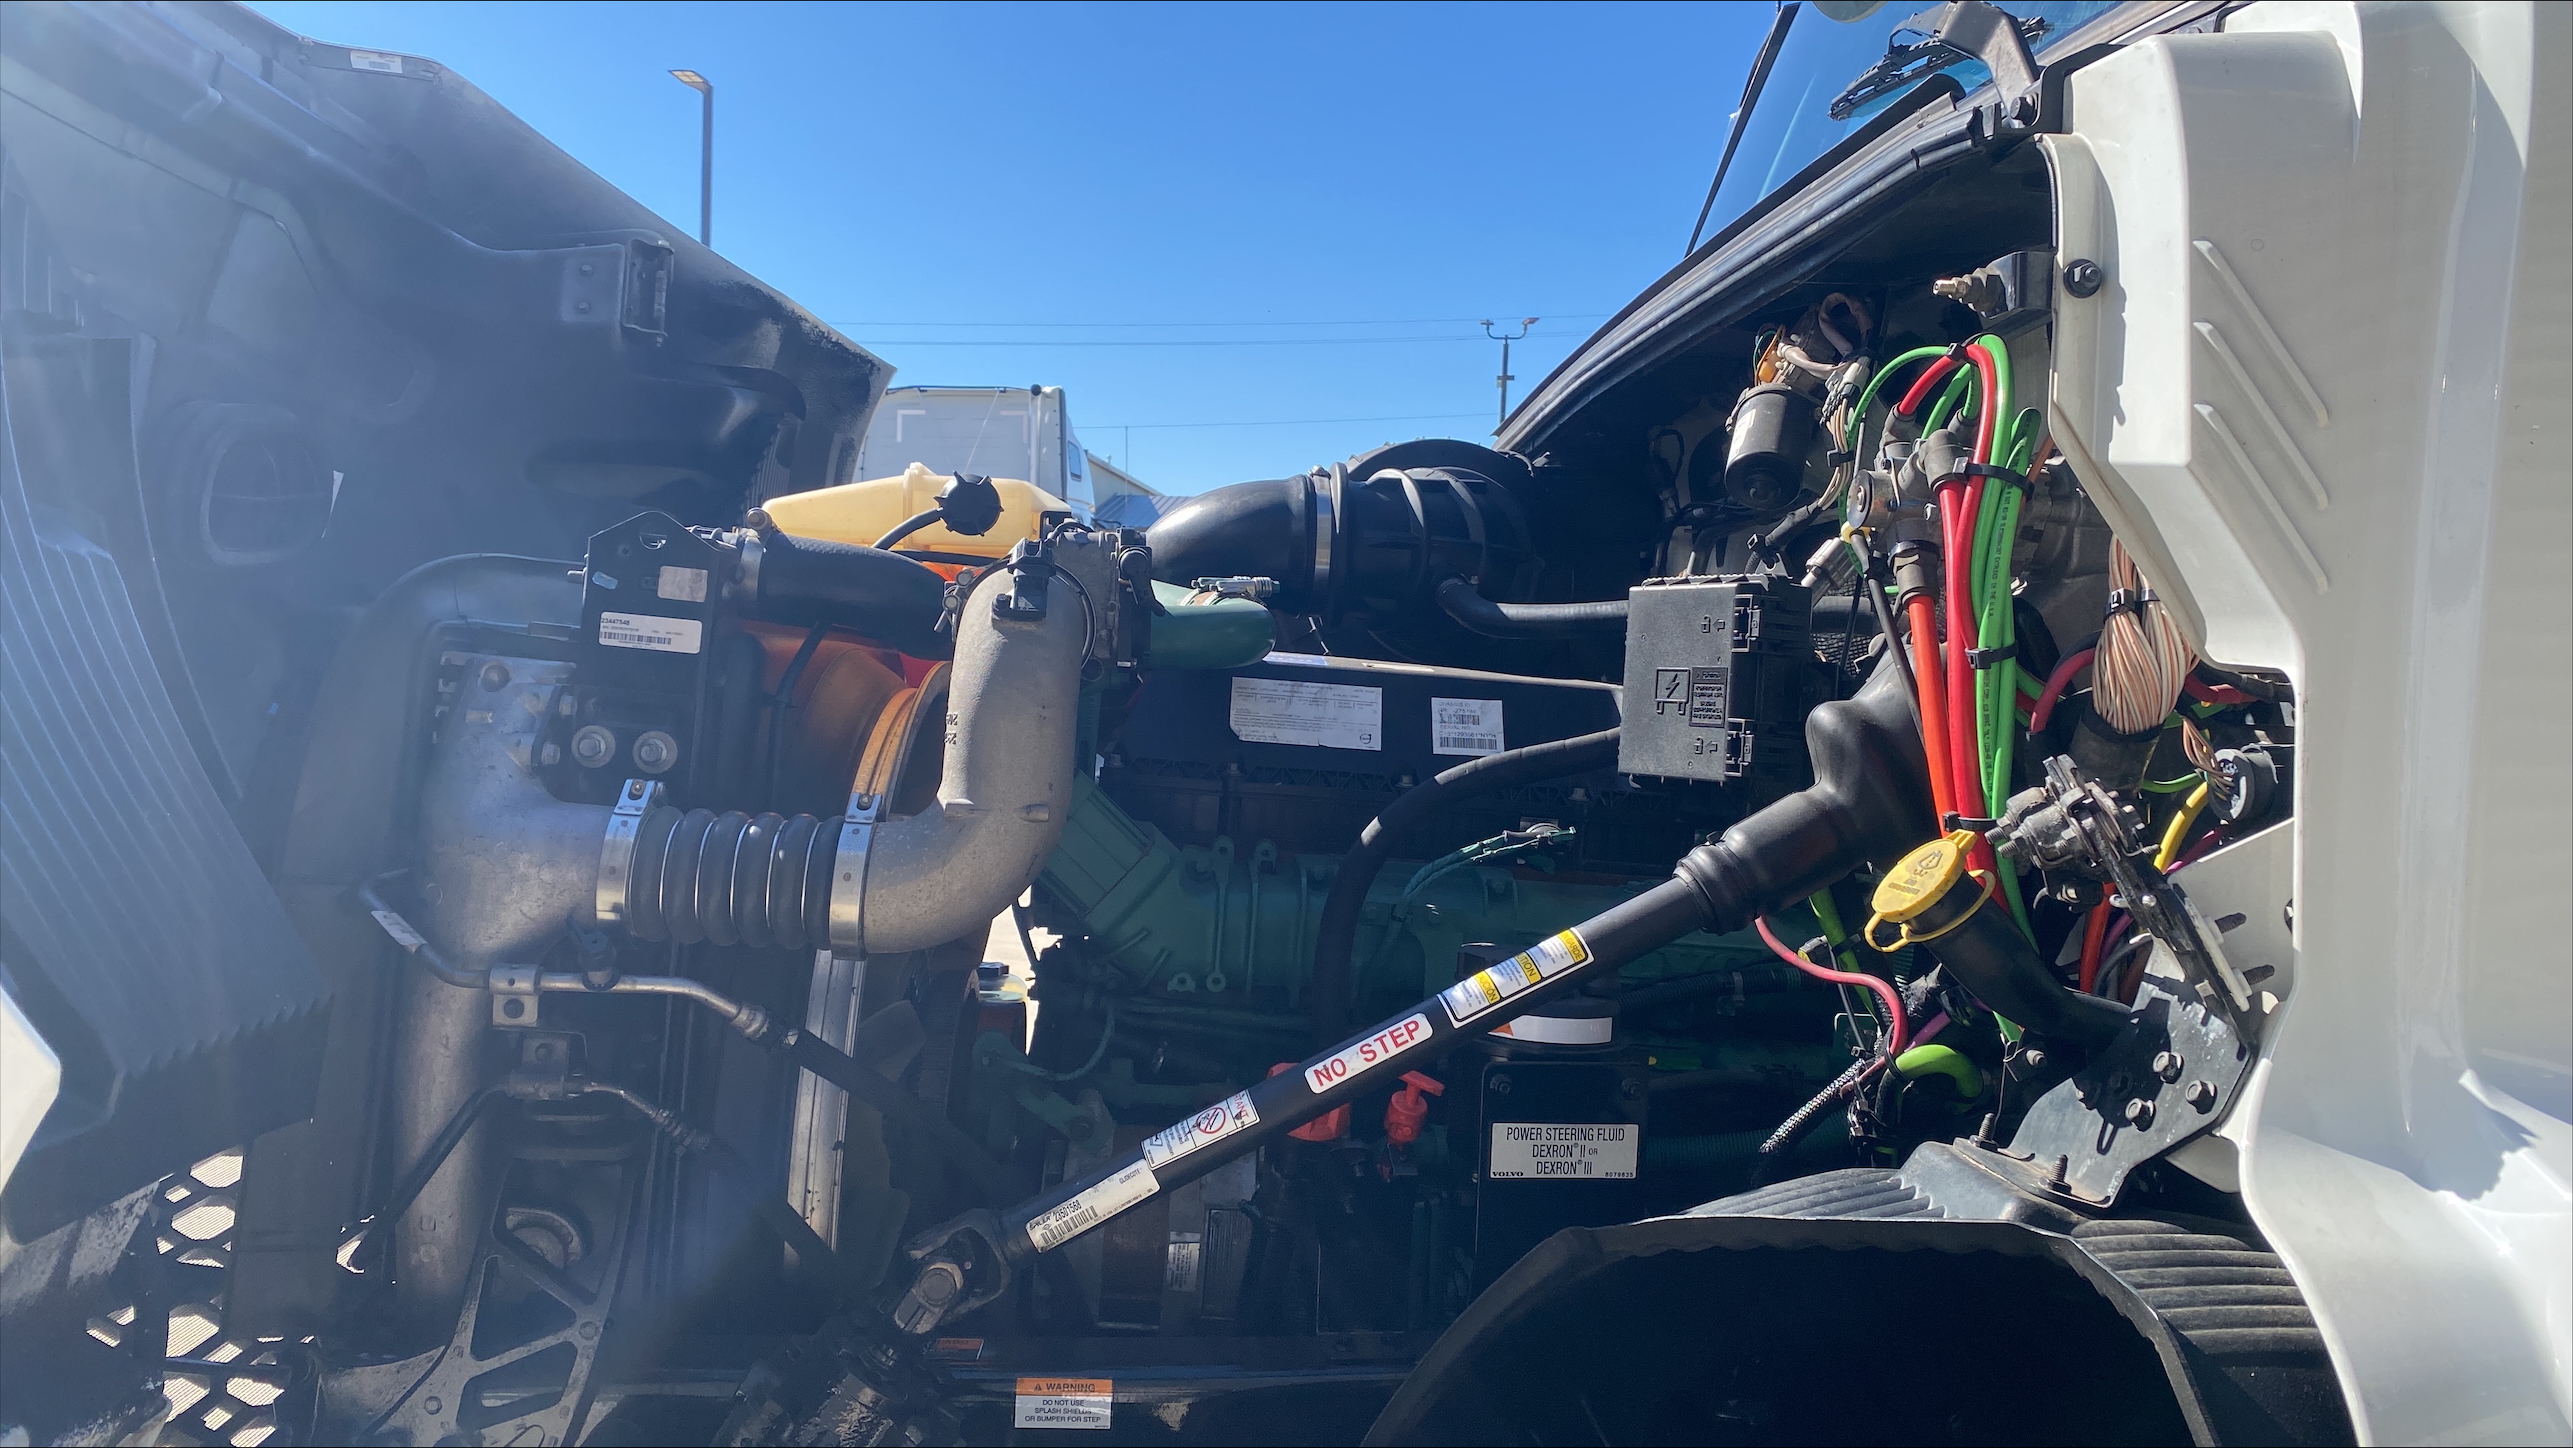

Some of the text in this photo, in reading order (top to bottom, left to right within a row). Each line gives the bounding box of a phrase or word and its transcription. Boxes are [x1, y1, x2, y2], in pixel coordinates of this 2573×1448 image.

[1313, 1020, 1420, 1087] NO STEP
[1506, 1127, 1625, 1142] POWER STEERING FLUID
[1580, 1144, 1586, 1158] II
[1588, 1148, 1599, 1156] OR
[1584, 1161, 1593, 1175] III
[1046, 1383, 1095, 1392] WARNING
[1063, 1407, 1092, 1415] SHIELDS
[1037, 1415, 1066, 1423] BUMPER
[1067, 1415, 1082, 1423] FOR
